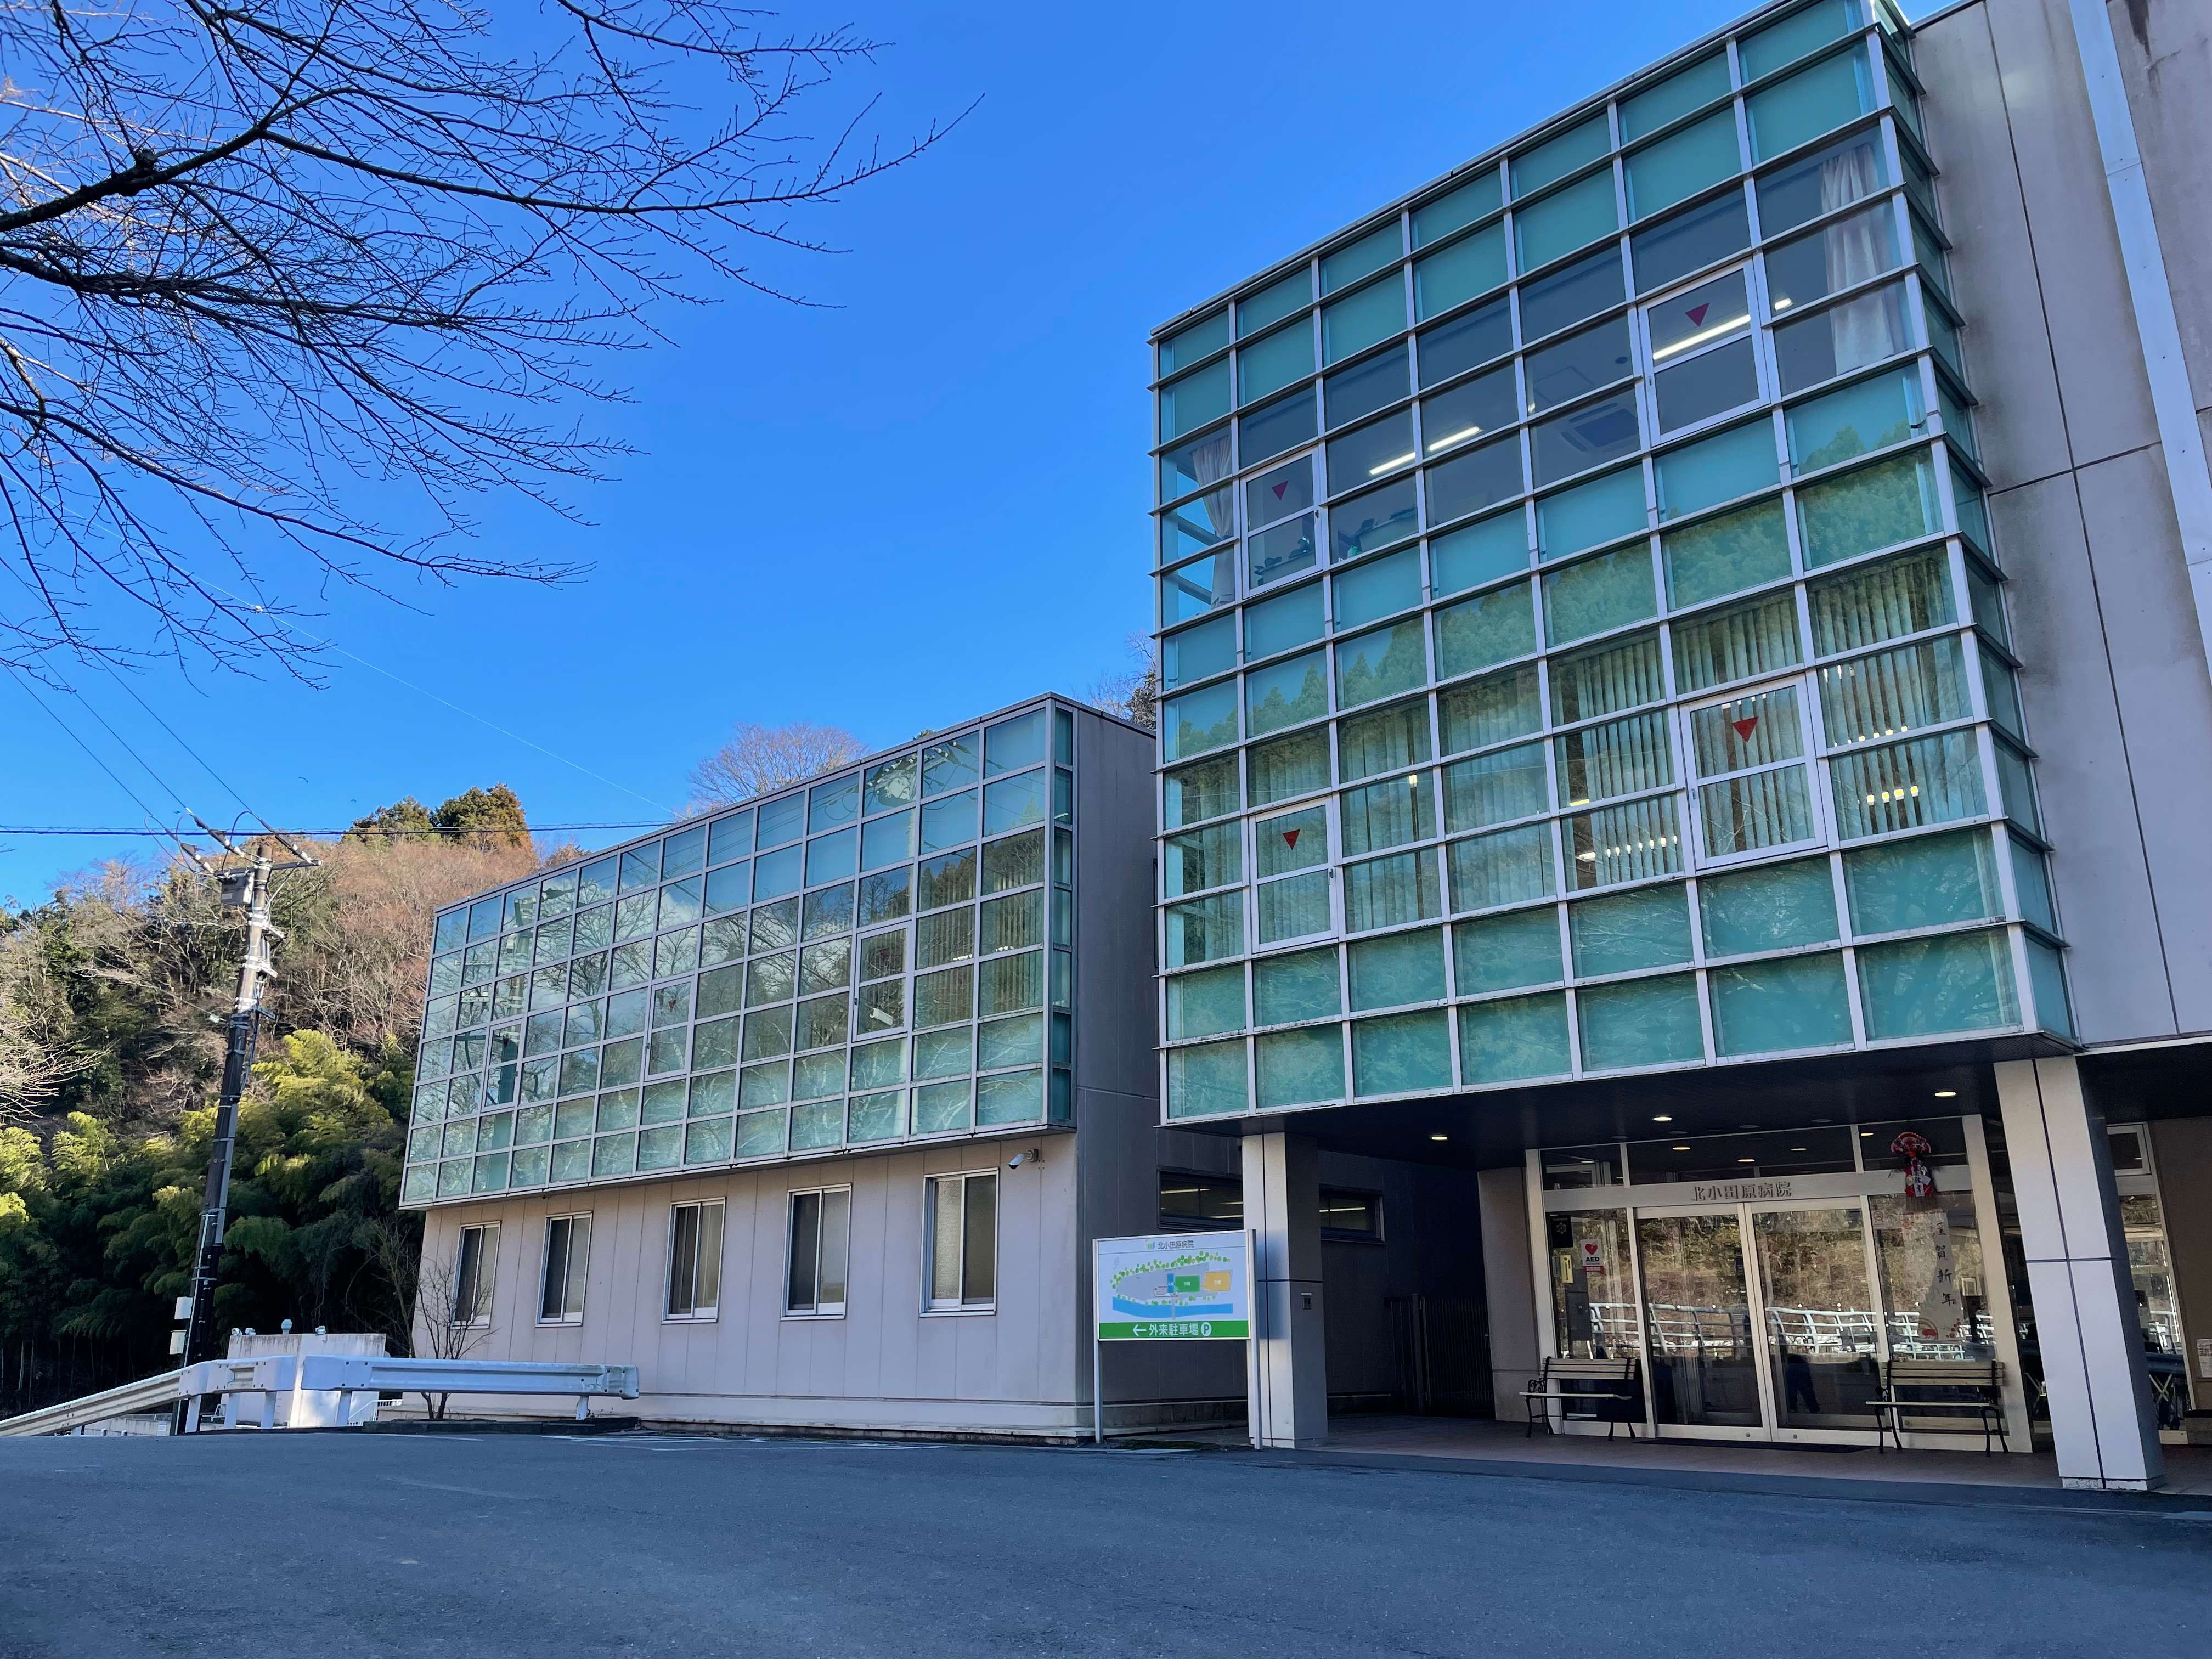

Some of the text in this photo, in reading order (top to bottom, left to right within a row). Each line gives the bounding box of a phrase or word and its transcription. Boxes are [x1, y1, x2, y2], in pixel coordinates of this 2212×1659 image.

[1692, 1181, 1792, 1201] 北小田原病院
[1158, 1240, 1194, 1249] 北小田原病院
[1149, 1323, 1210, 1336] 外来駐車場 P
